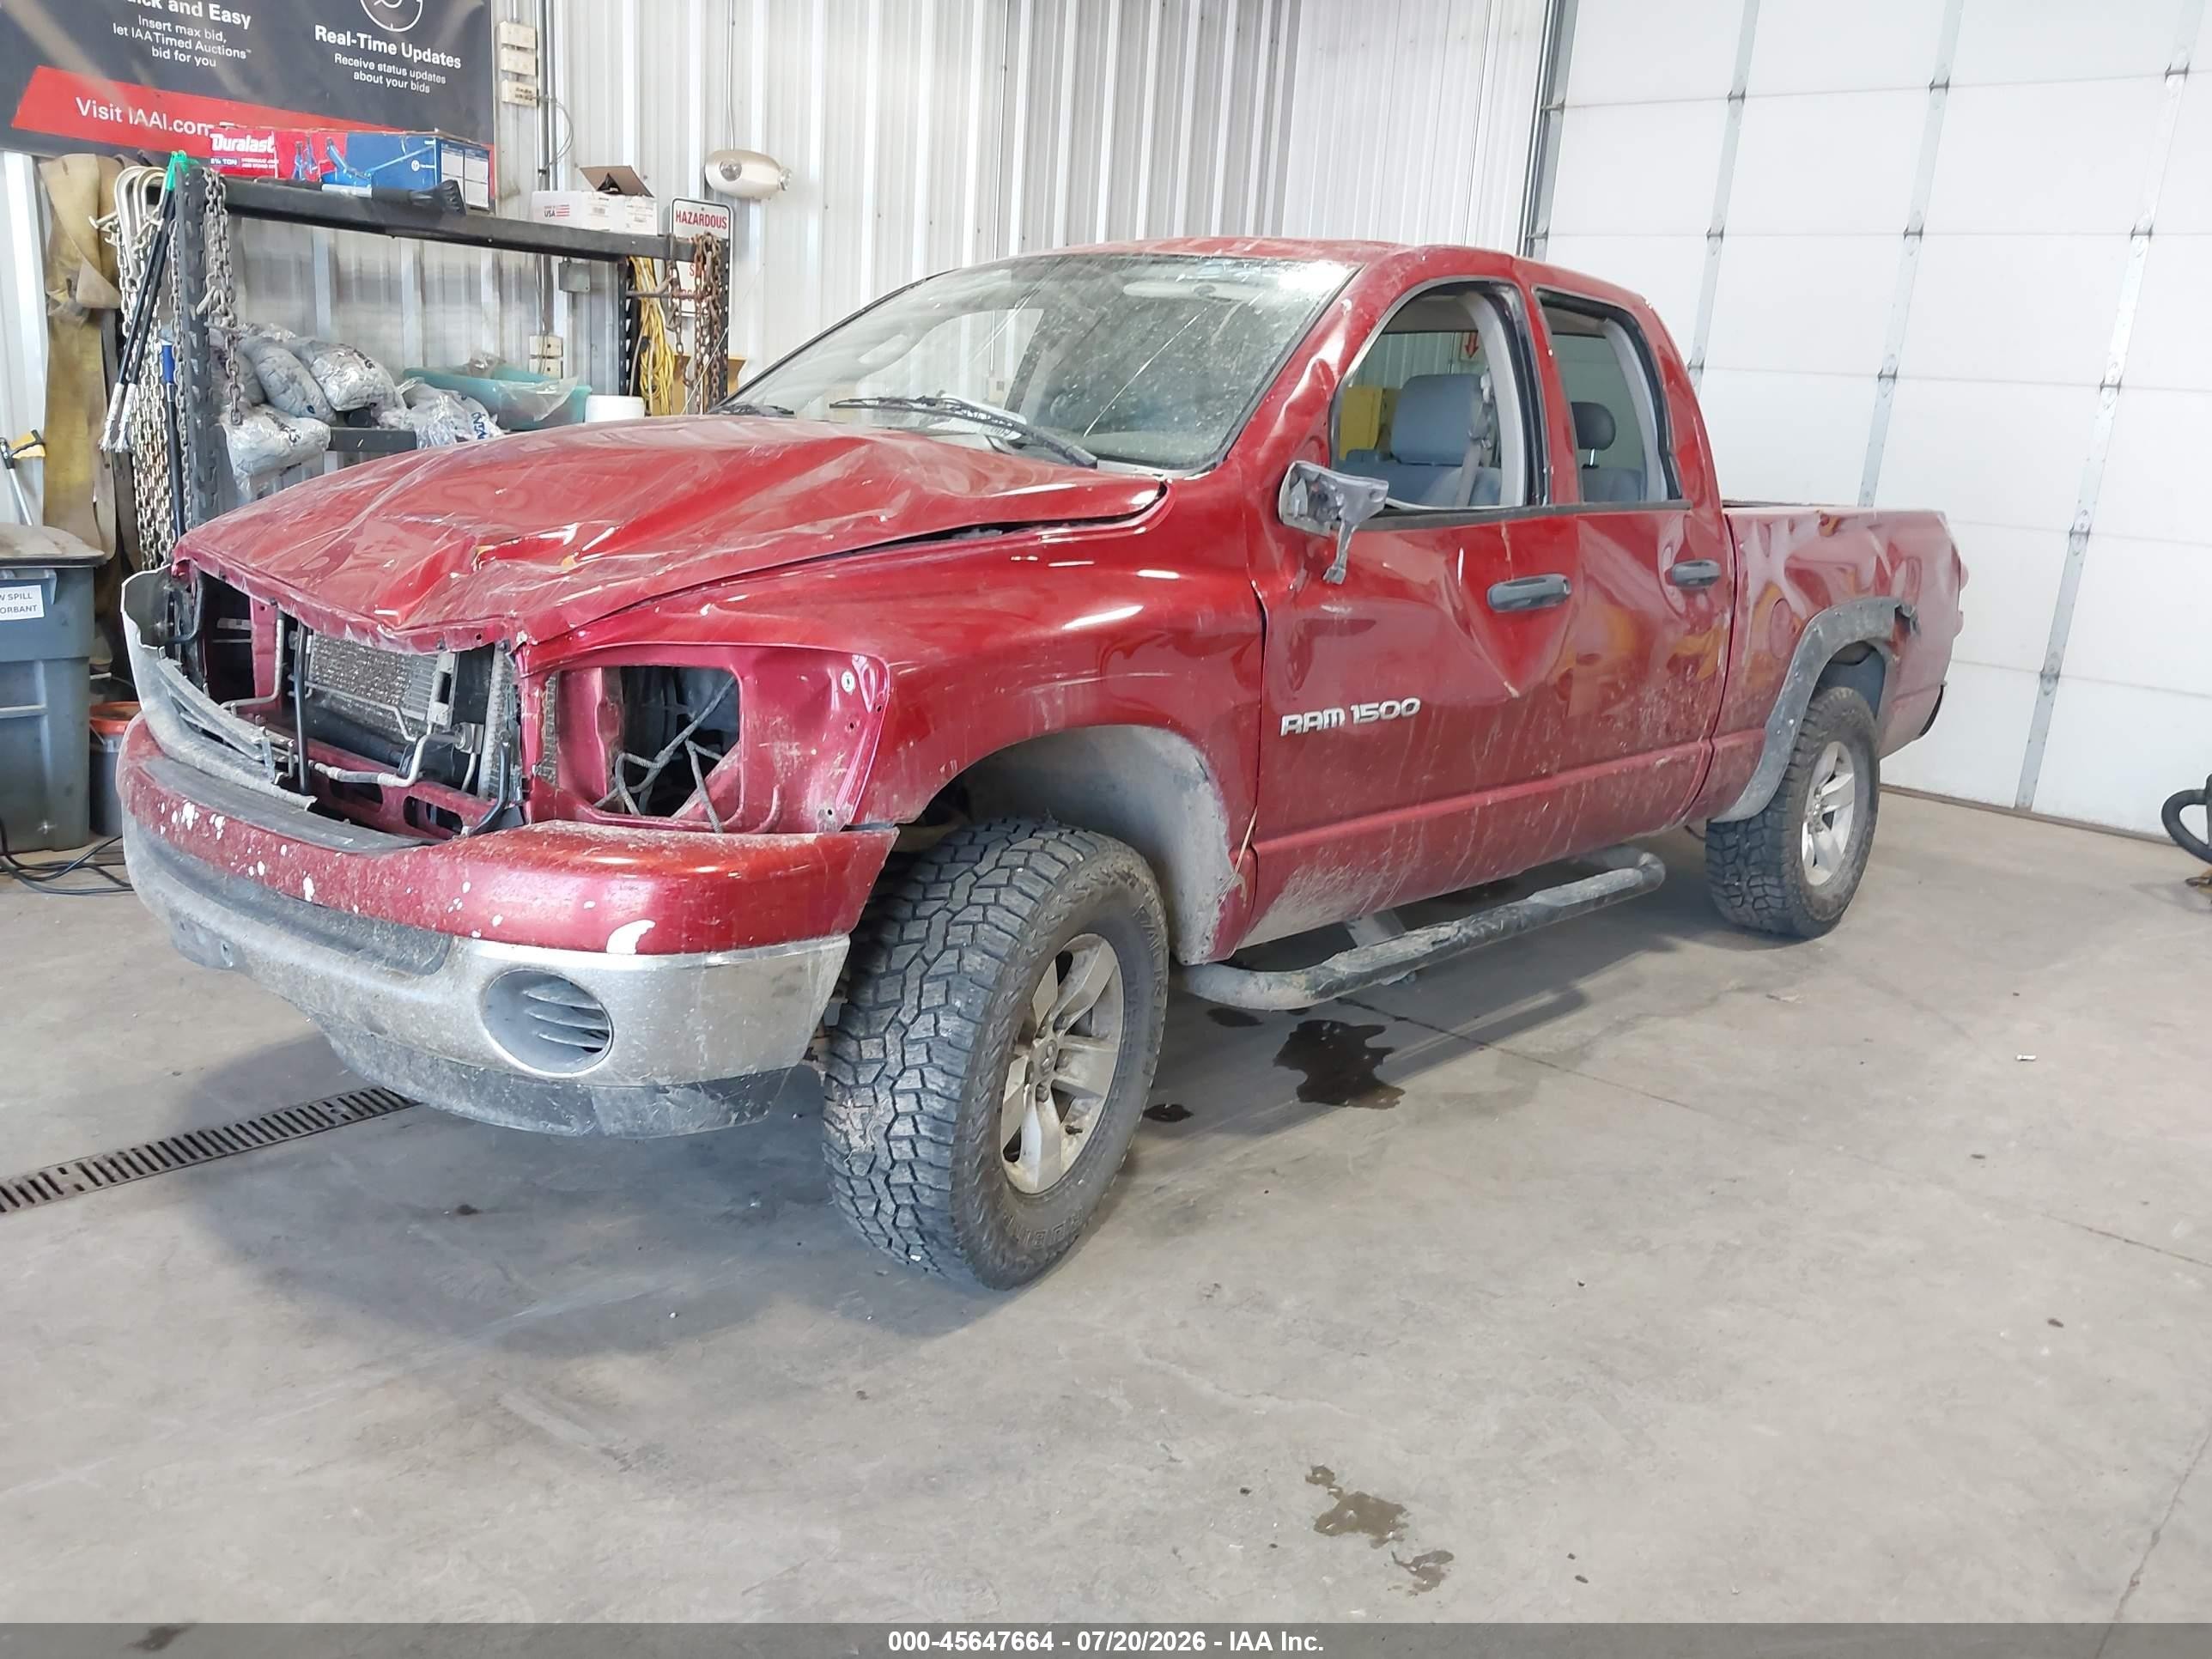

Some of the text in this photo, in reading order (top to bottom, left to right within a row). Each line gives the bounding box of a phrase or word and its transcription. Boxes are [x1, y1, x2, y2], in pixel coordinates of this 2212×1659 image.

[138, 15, 227, 43] Insert max bid,
[168, 0, 203, 17] and
[209, 3, 252, 30] Easy
[112, 23, 129, 36] let
[151, 46, 216, 67] bid for you
[314, 24, 461, 69] Real-Time Updates
[334, 52, 447, 84] Receive status updates
[353, 70, 430, 94] about your bids
[76, 96, 213, 137] Visit IAAI.com
[210, 133, 276, 153] Duralast
[675, 210, 727, 230] HAZARDOUS
[1280, 697, 1421, 736] RAM 1500
